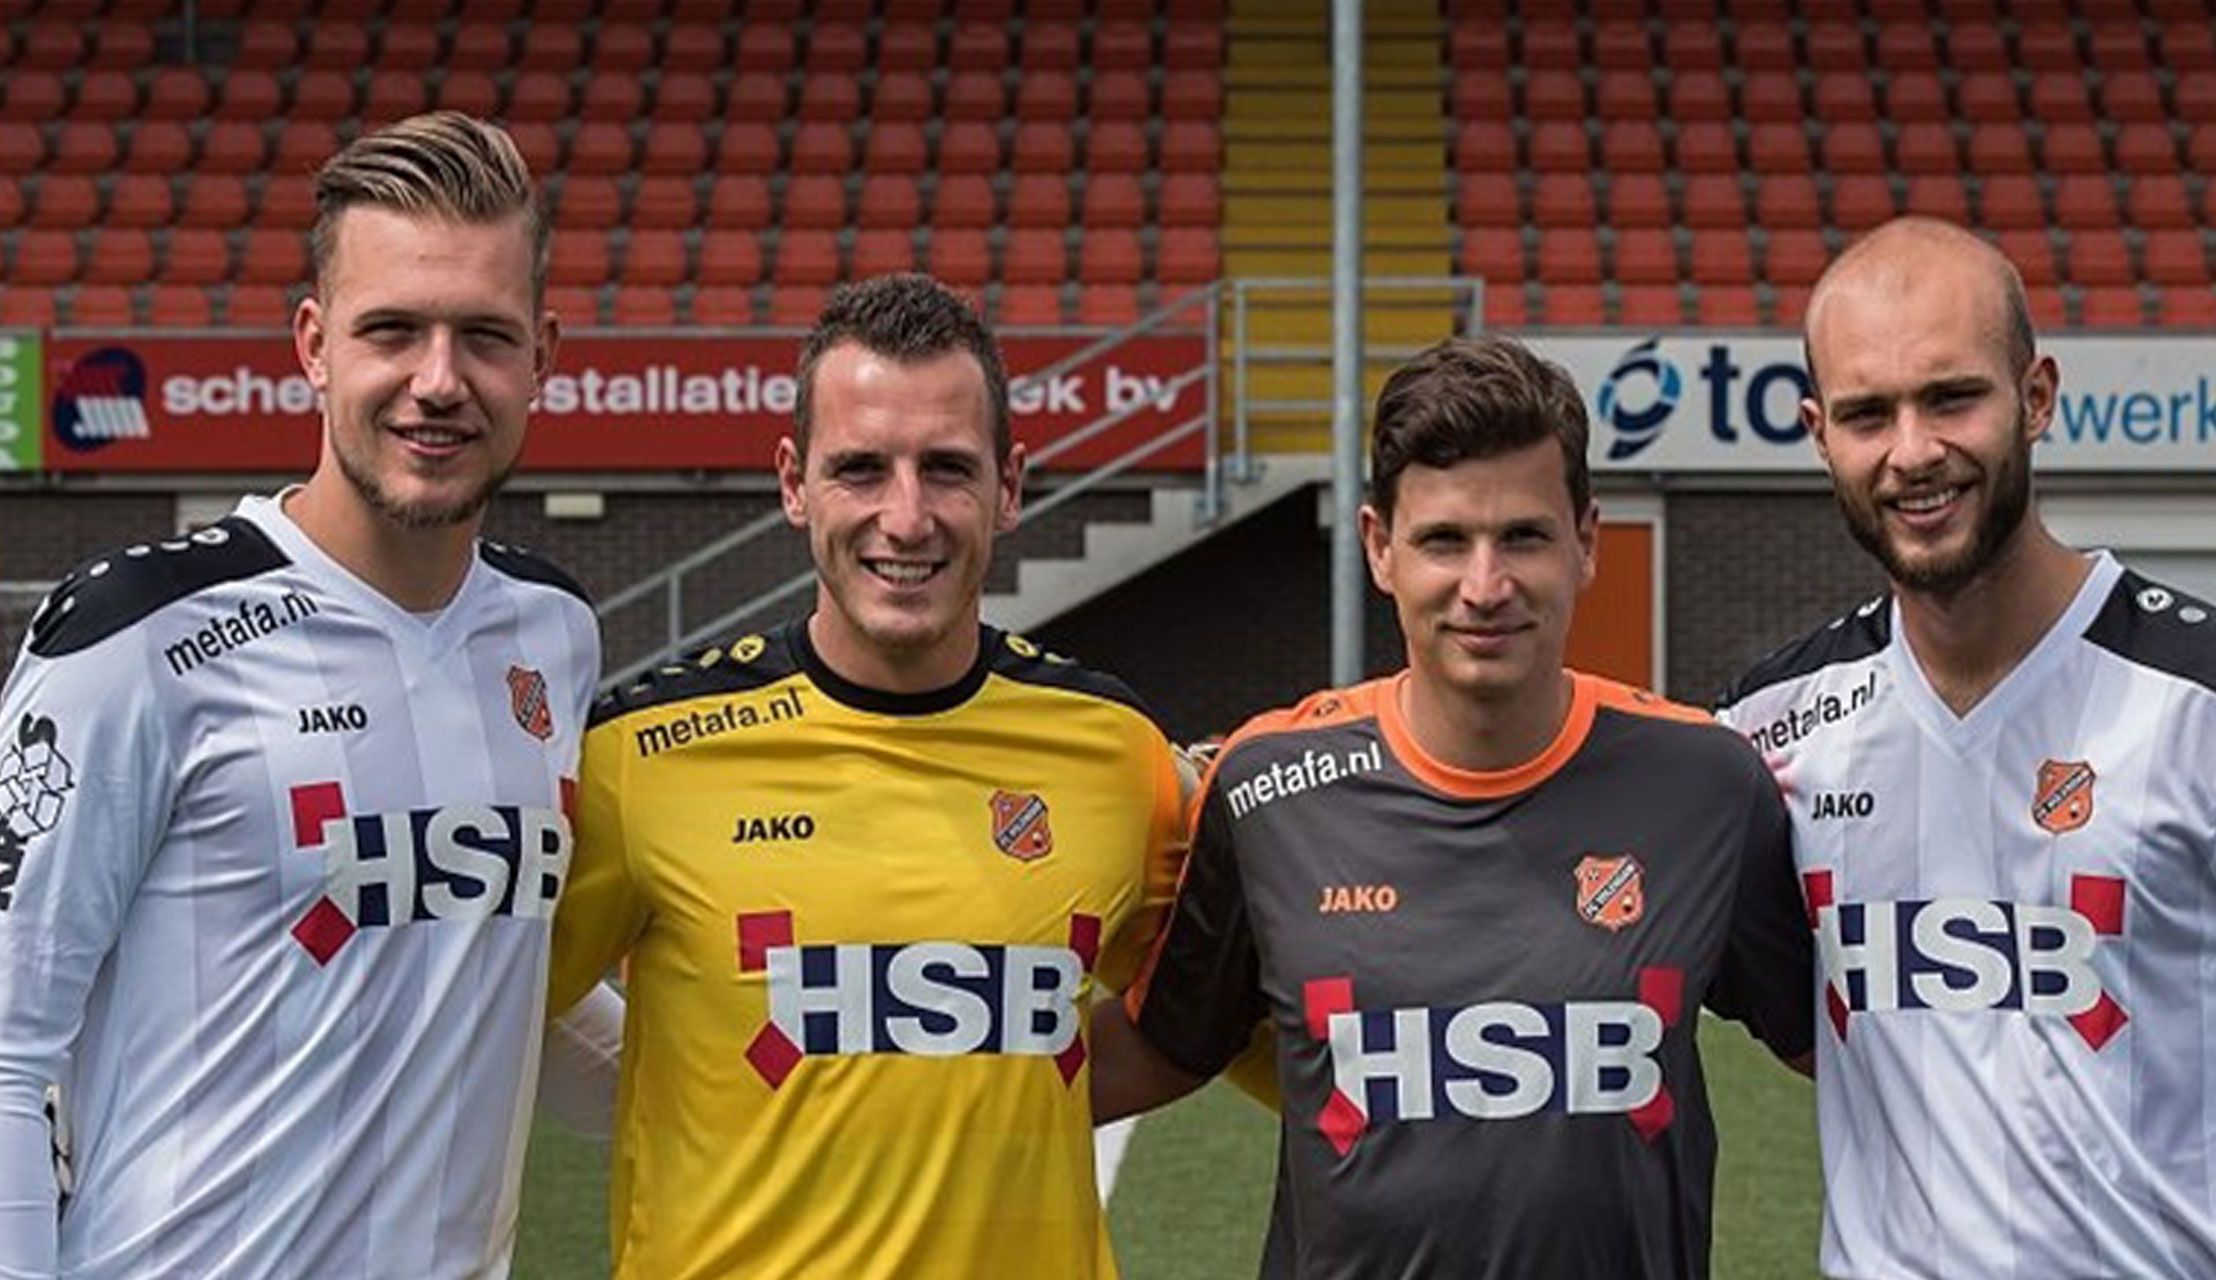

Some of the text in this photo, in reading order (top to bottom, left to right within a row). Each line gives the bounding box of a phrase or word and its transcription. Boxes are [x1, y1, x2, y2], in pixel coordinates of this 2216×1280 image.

[162, 367, 325, 414] sche
[529, 366, 798, 413] stallatie
[1106, 366, 1178, 415] bv
[2041, 374, 2216, 445] werk
[163, 592, 319, 677] metafa.nl
[298, 704, 368, 734] JAKO
[635, 687, 804, 758] metafa.nl
[1226, 742, 1384, 820] metafa.nl
[1812, 791, 1875, 820] JAKO
[731, 814, 815, 844] JAKO
[323, 804, 574, 926] HSB
[1319, 885, 1398, 913] JAKO
[1816, 900, 2102, 1016] HSB
[766, 941, 1086, 1057] HSB
[1328, 1002, 1664, 1121] HSB
